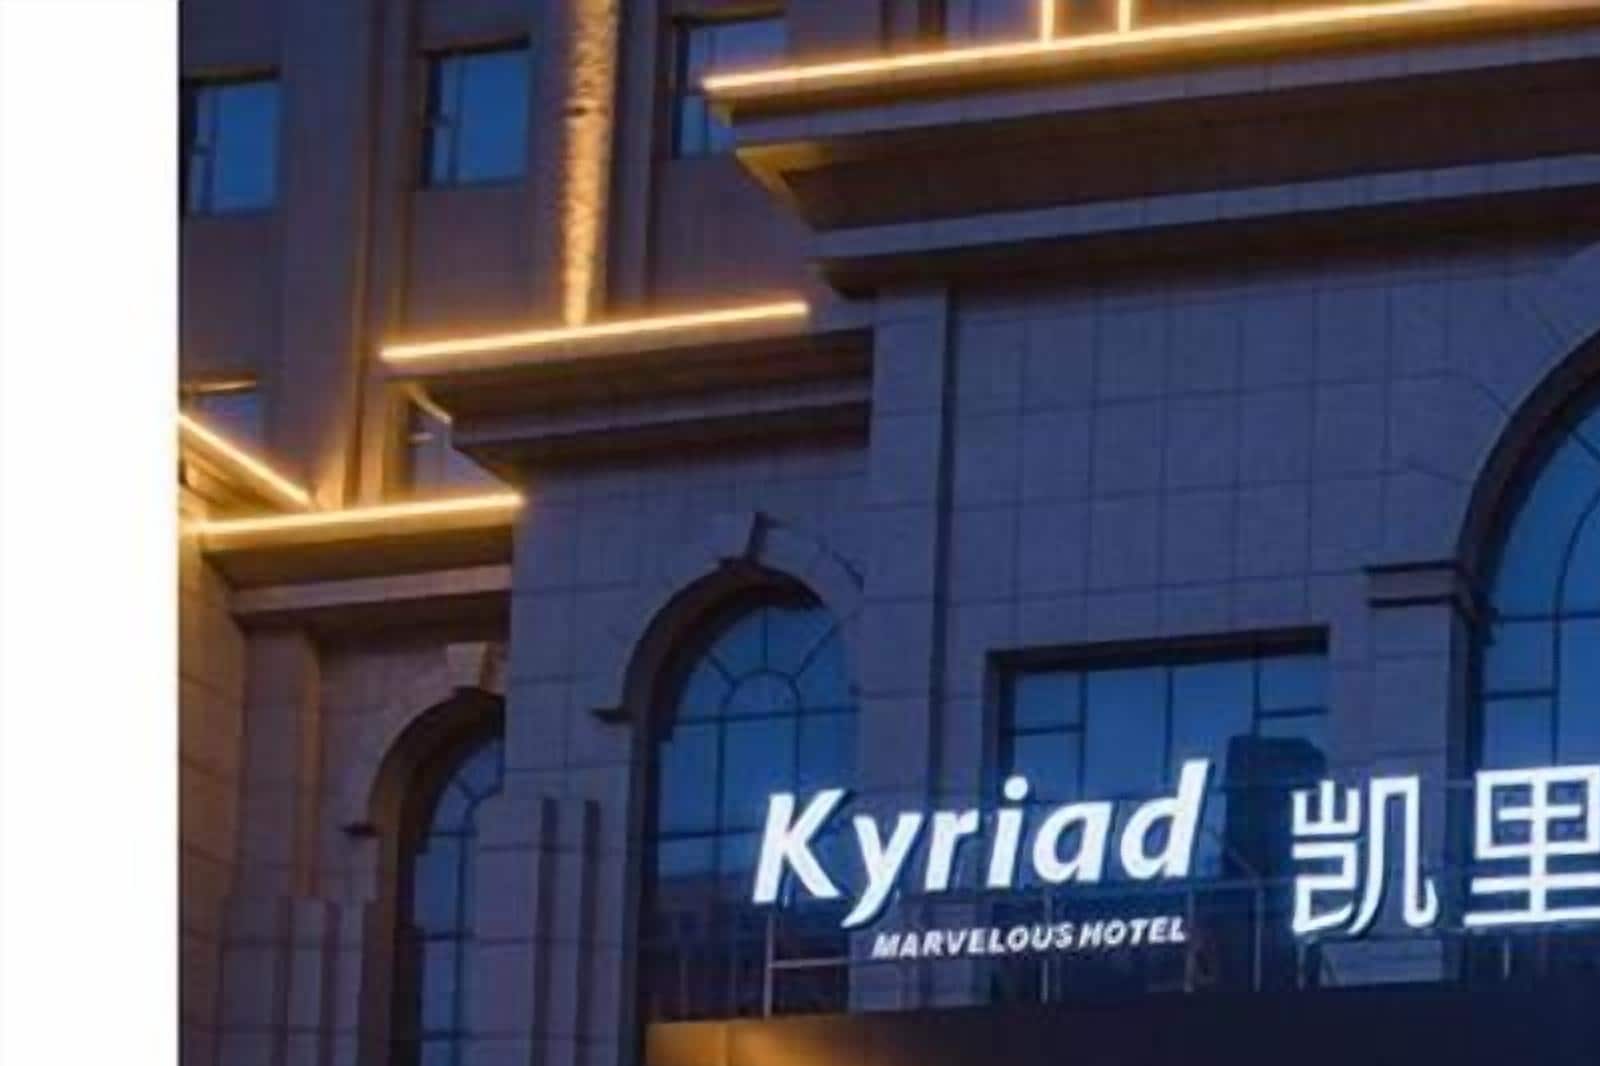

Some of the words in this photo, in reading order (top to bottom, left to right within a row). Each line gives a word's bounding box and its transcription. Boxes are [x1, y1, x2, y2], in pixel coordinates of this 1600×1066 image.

[752, 759, 1209, 928] Kyriad
[871, 921, 1073, 960] MARVELOUS
[1078, 916, 1188, 949] HOTEL
